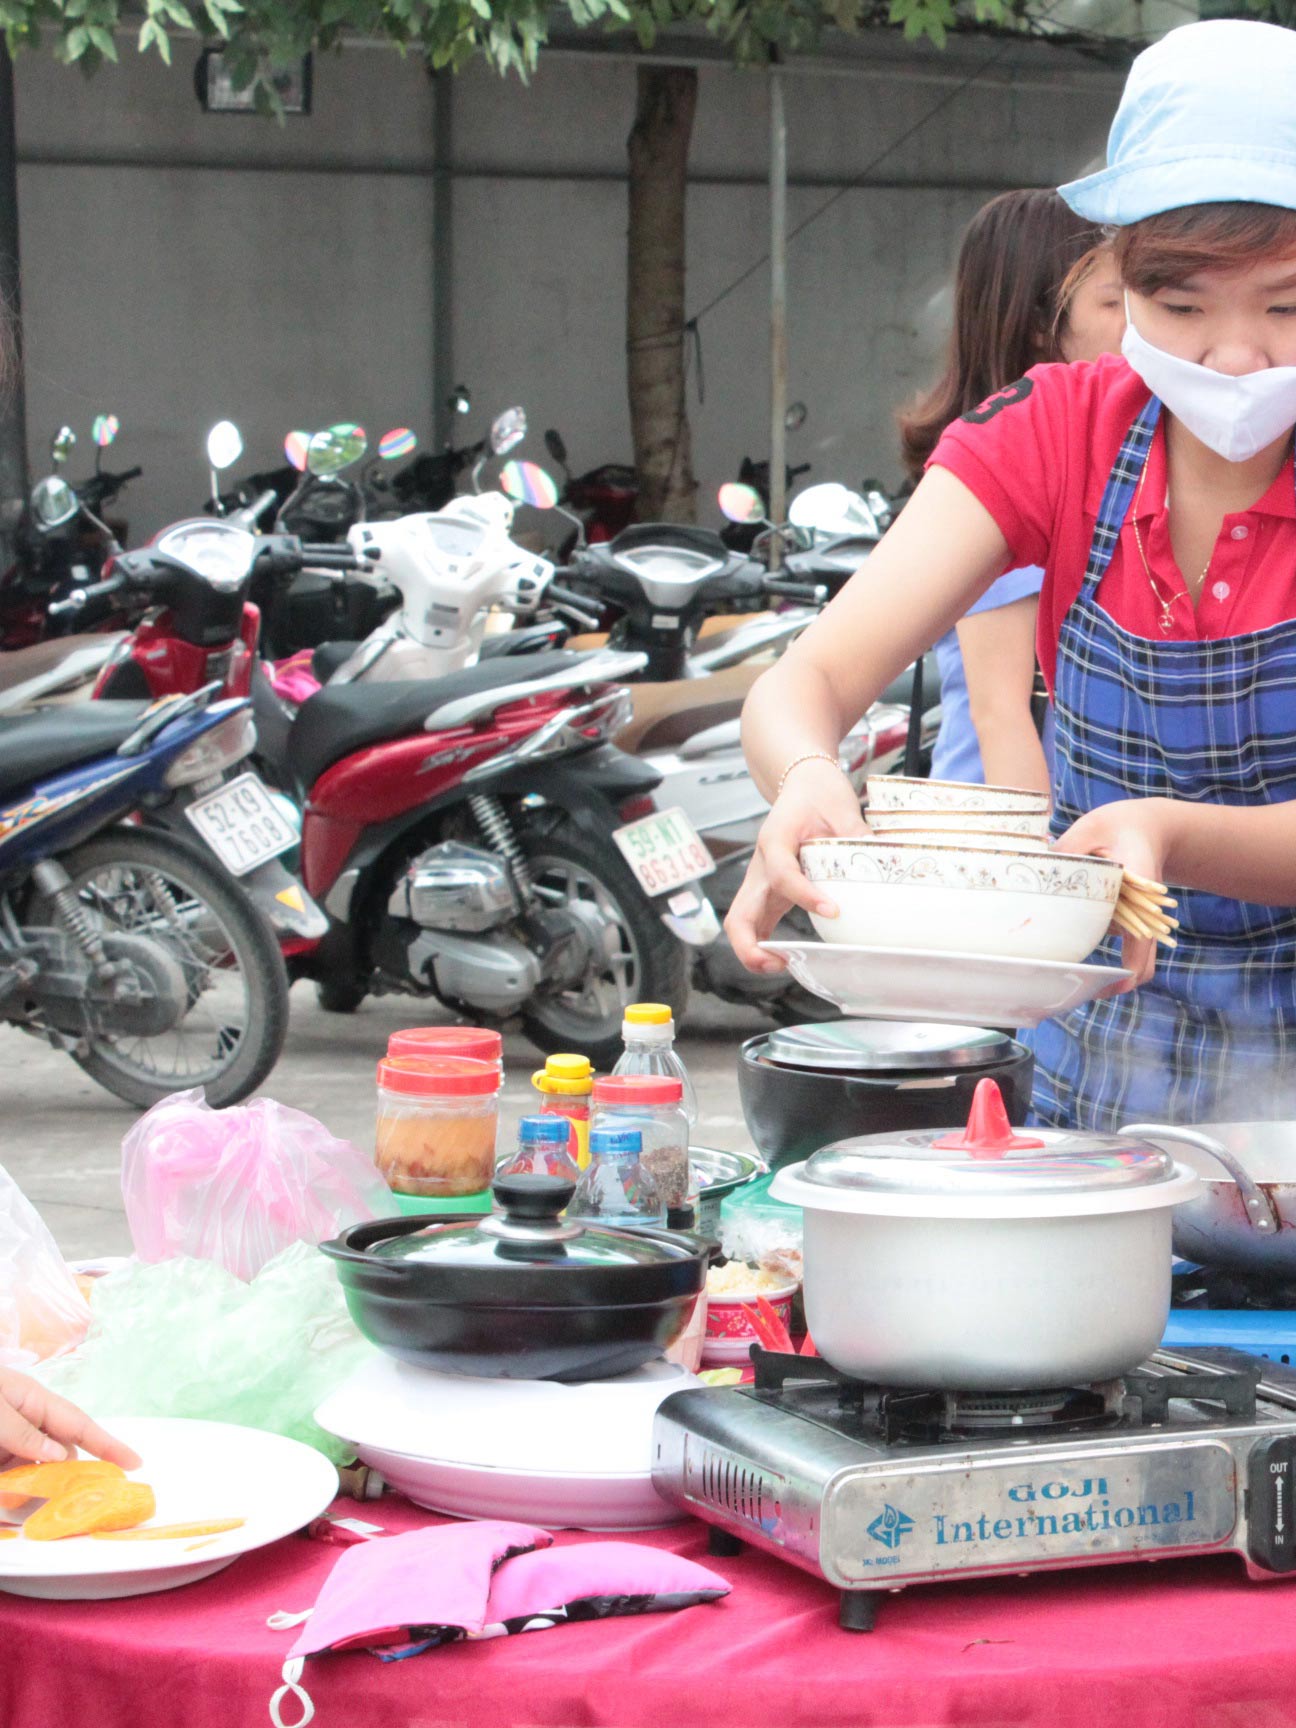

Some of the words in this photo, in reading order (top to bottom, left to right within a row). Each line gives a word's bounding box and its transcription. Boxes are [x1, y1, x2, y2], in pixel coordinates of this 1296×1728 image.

[1270, 1462, 1288, 1474] OUT
[932, 1490, 1197, 1546] International
[1275, 1535, 1284, 1545] IN
